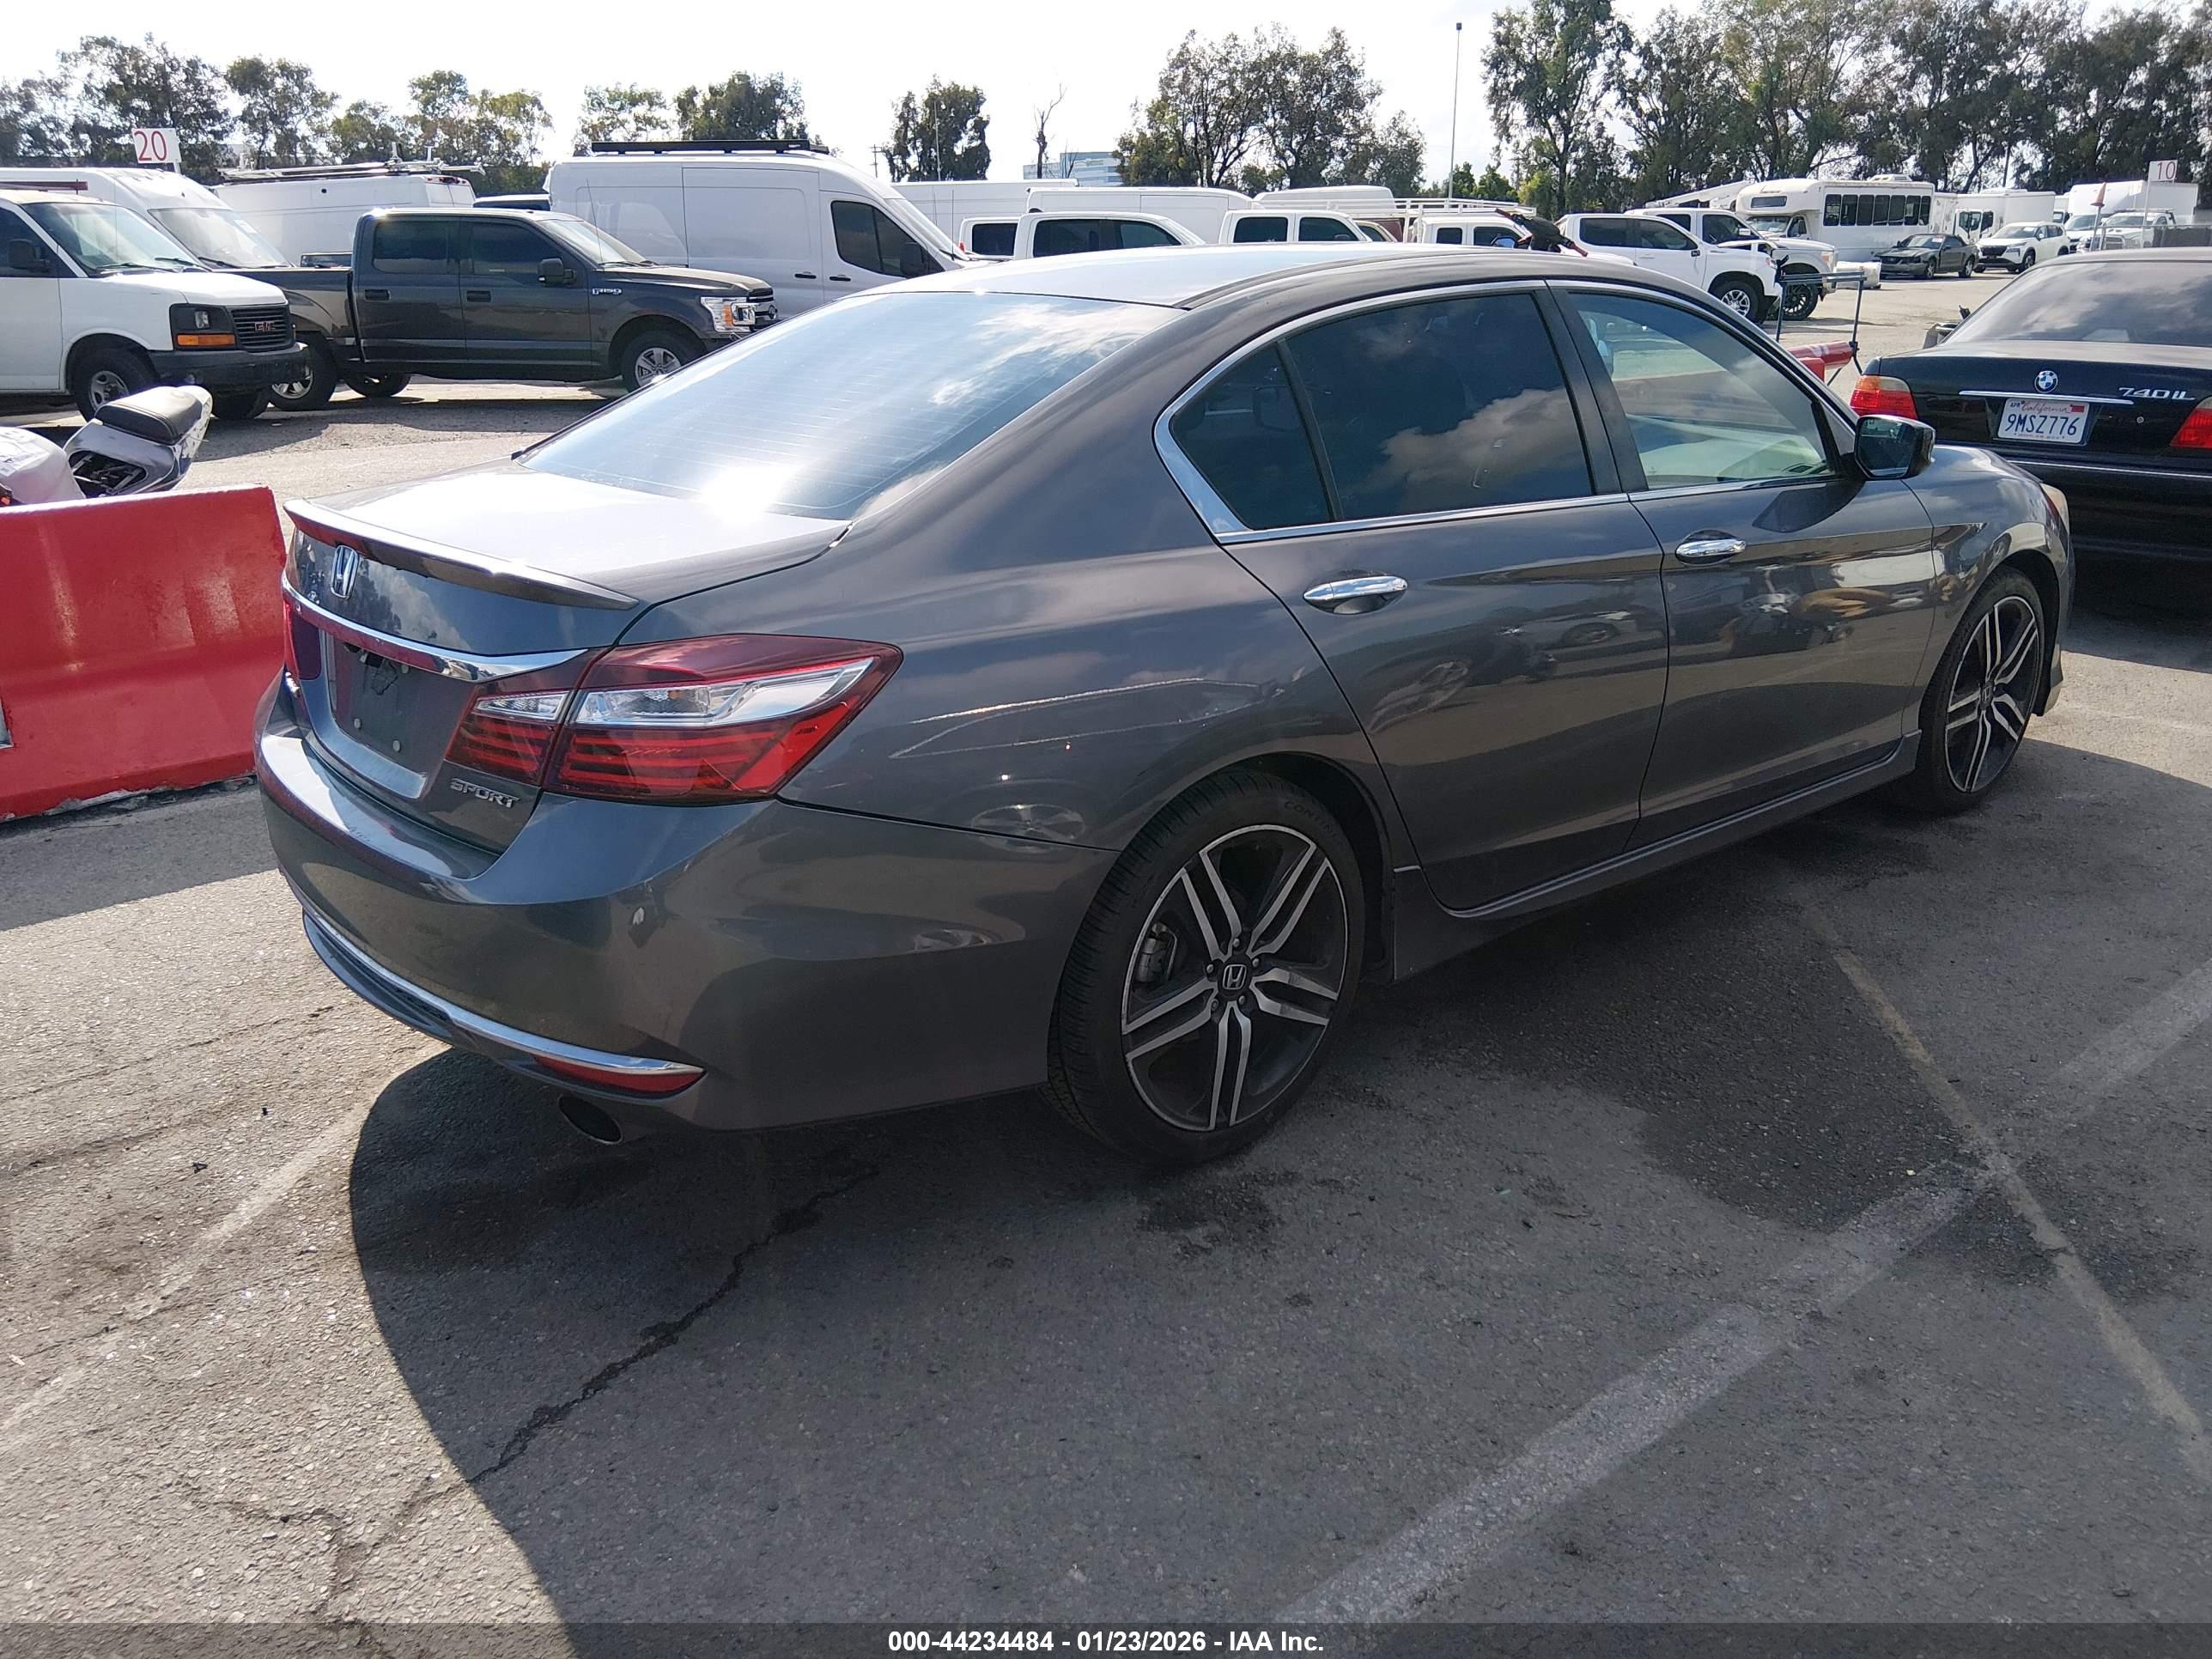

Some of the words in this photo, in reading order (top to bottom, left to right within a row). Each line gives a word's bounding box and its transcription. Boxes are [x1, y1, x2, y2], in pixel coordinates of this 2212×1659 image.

[134, 131, 167, 161] 20
[2157, 161, 2176, 179] 10
[2021, 401, 2070, 415] California
[2005, 413, 2080, 435] 9MSZ776
[450, 777, 520, 808] SPORT
